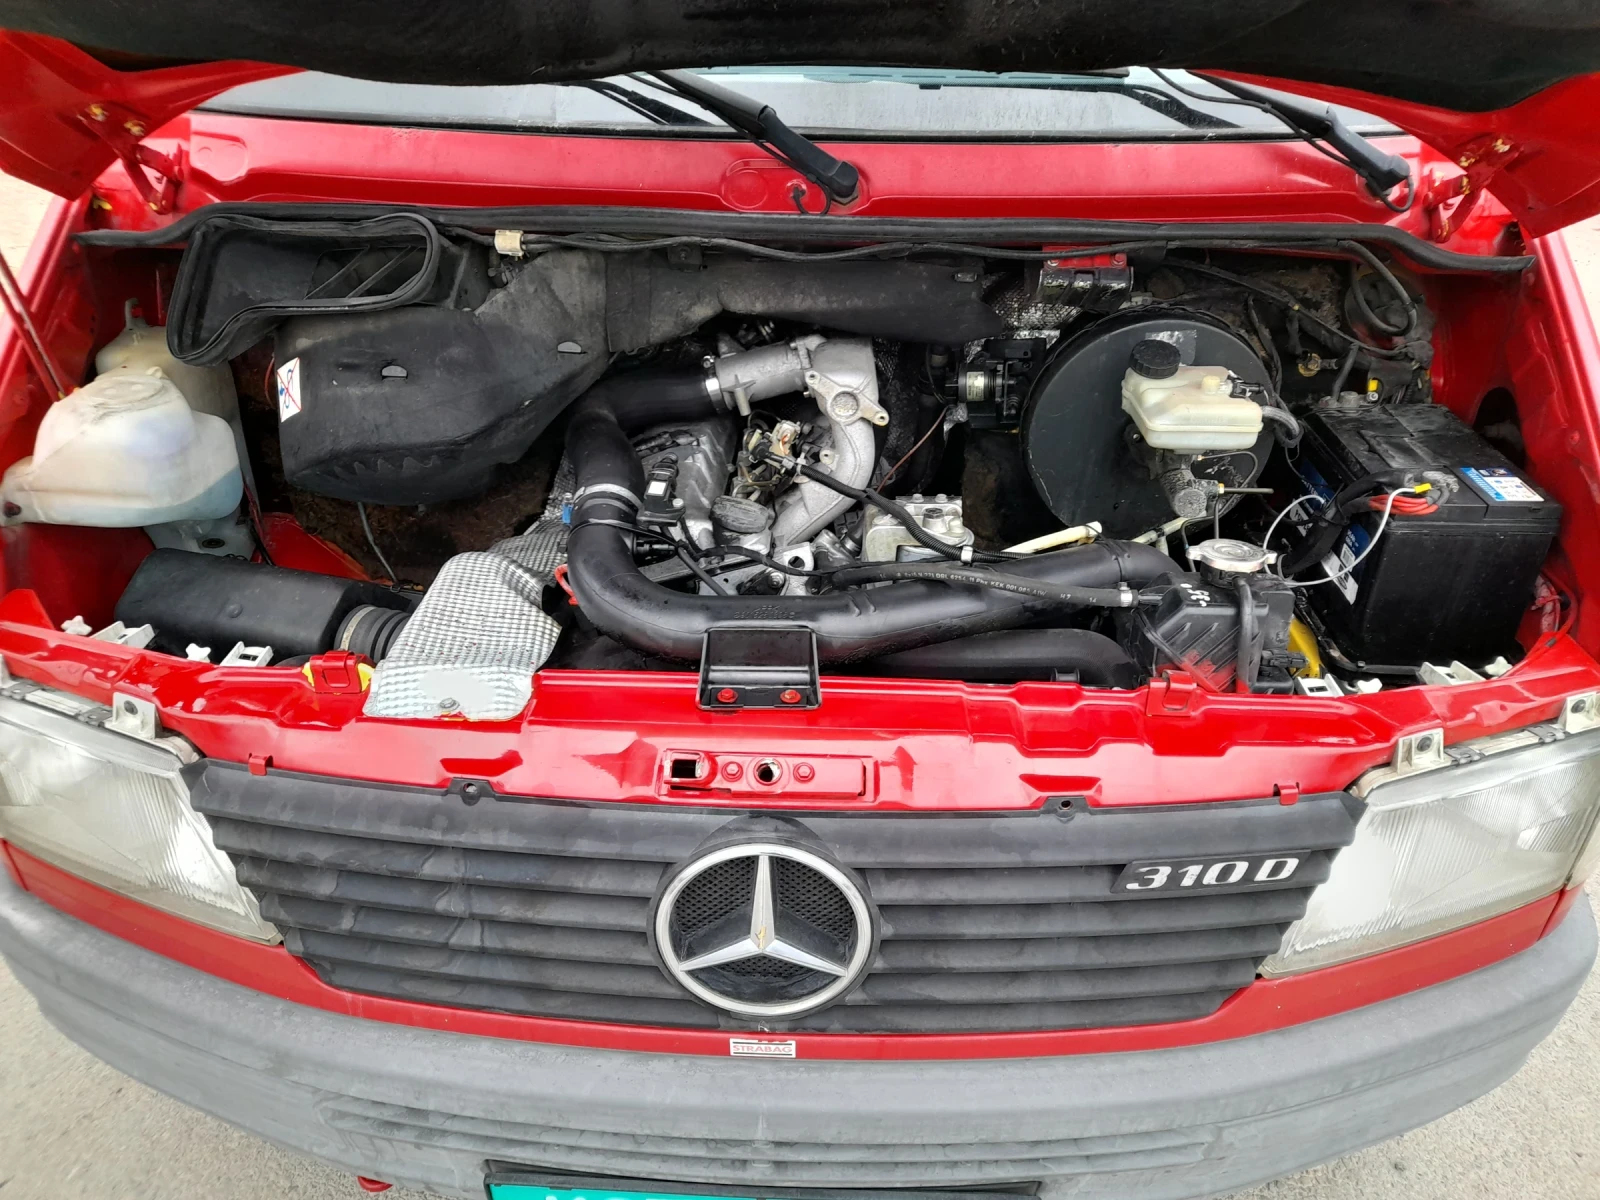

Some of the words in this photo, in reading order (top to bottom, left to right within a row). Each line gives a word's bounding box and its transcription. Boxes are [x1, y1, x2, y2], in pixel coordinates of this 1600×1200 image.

[1125, 861, 1249, 890] 310
[1253, 857, 1300, 882] D
[732, 1044, 793, 1054] STRABAG
